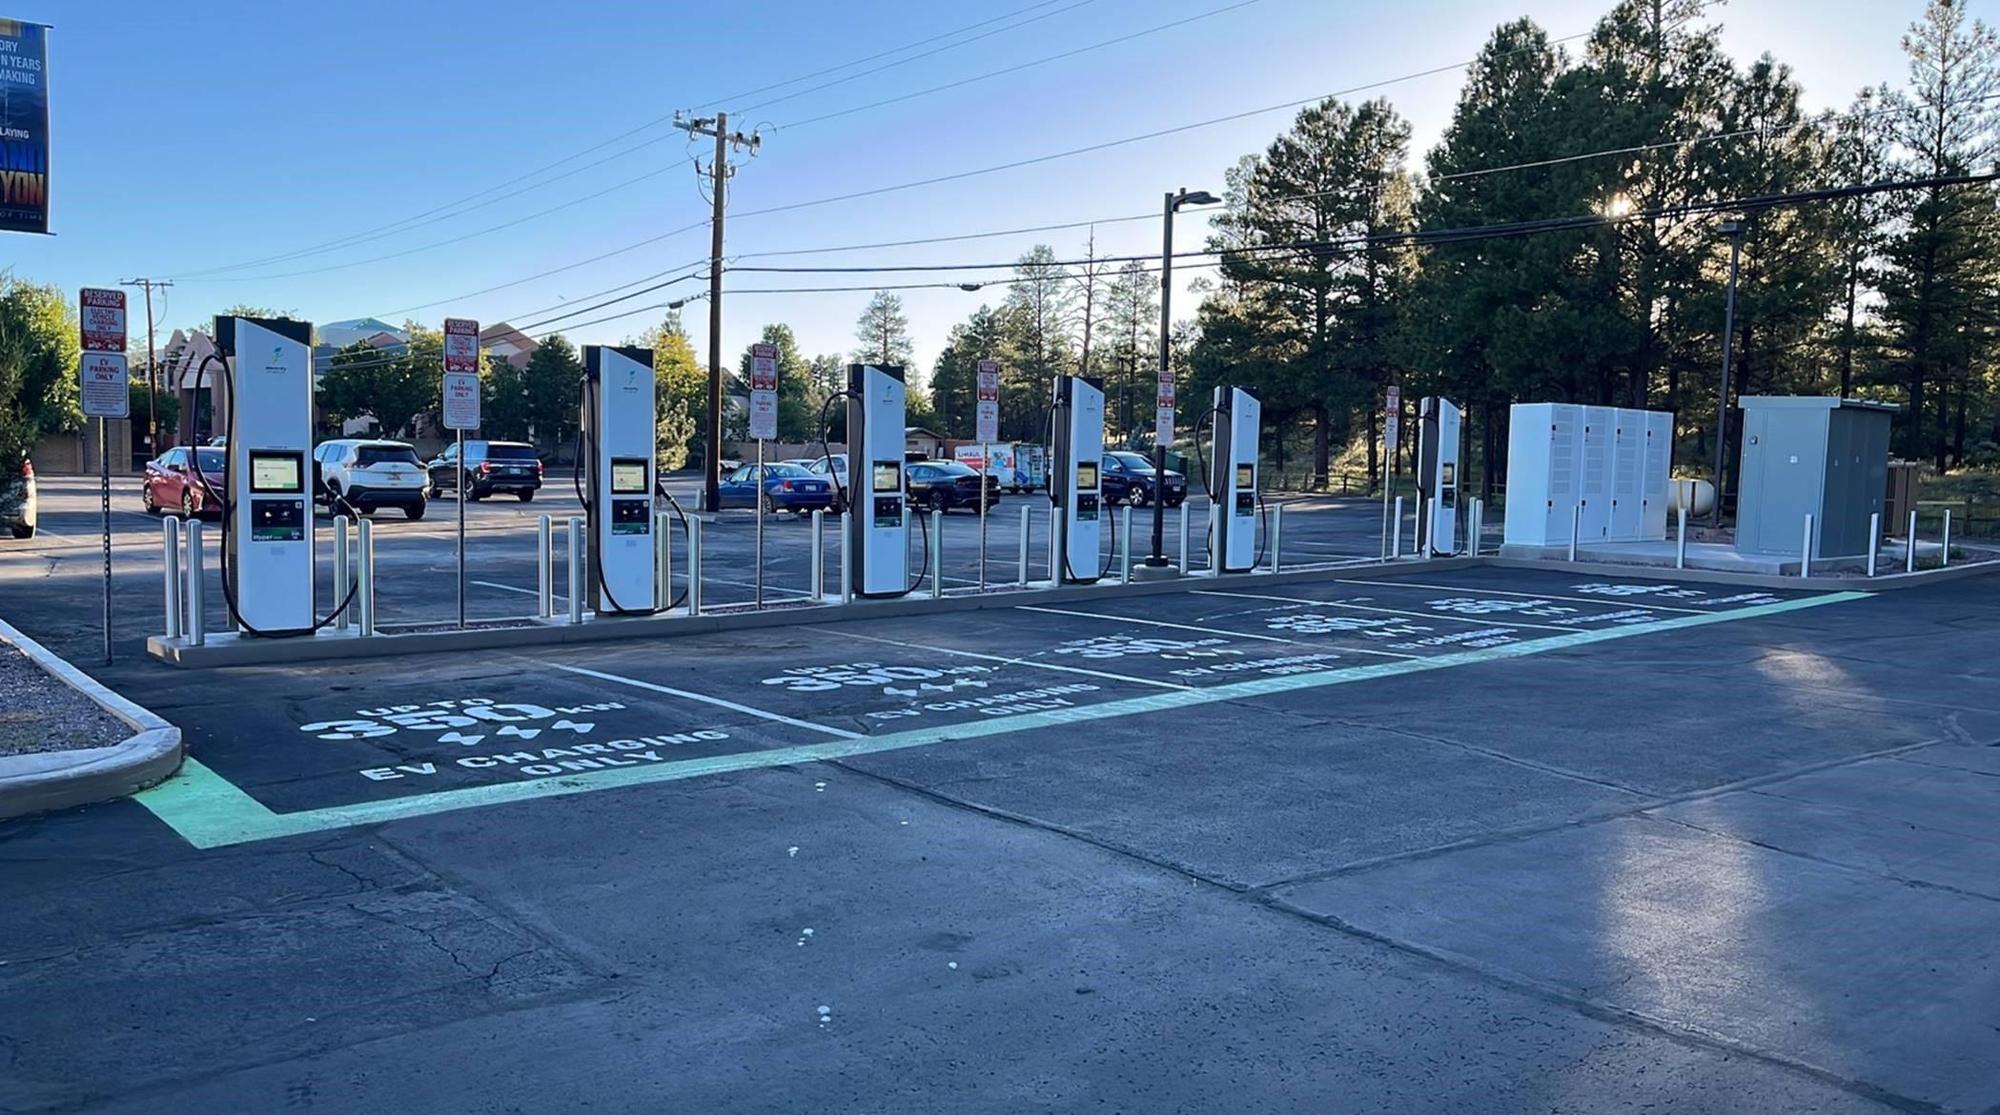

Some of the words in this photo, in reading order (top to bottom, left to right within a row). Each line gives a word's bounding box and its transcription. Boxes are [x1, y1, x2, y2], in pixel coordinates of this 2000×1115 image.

[10, 56, 41, 71] YEARS
[87, 297, 120, 307] PARKING
[89, 365, 119, 374] PARKING
[95, 373, 114, 381] ONLY
[829, 662, 881, 671] TO
[761, 666, 943, 692] 350
[923, 683, 1101, 712] CHARGING
[356, 704, 421, 717] UP
[426, 698, 495, 709] TO
[979, 698, 1075, 716] ONLY
[300, 703, 556, 741] 350
[359, 762, 437, 781] EV
[456, 729, 730, 768] CHARGING
[520, 750, 664, 776] ONLY
